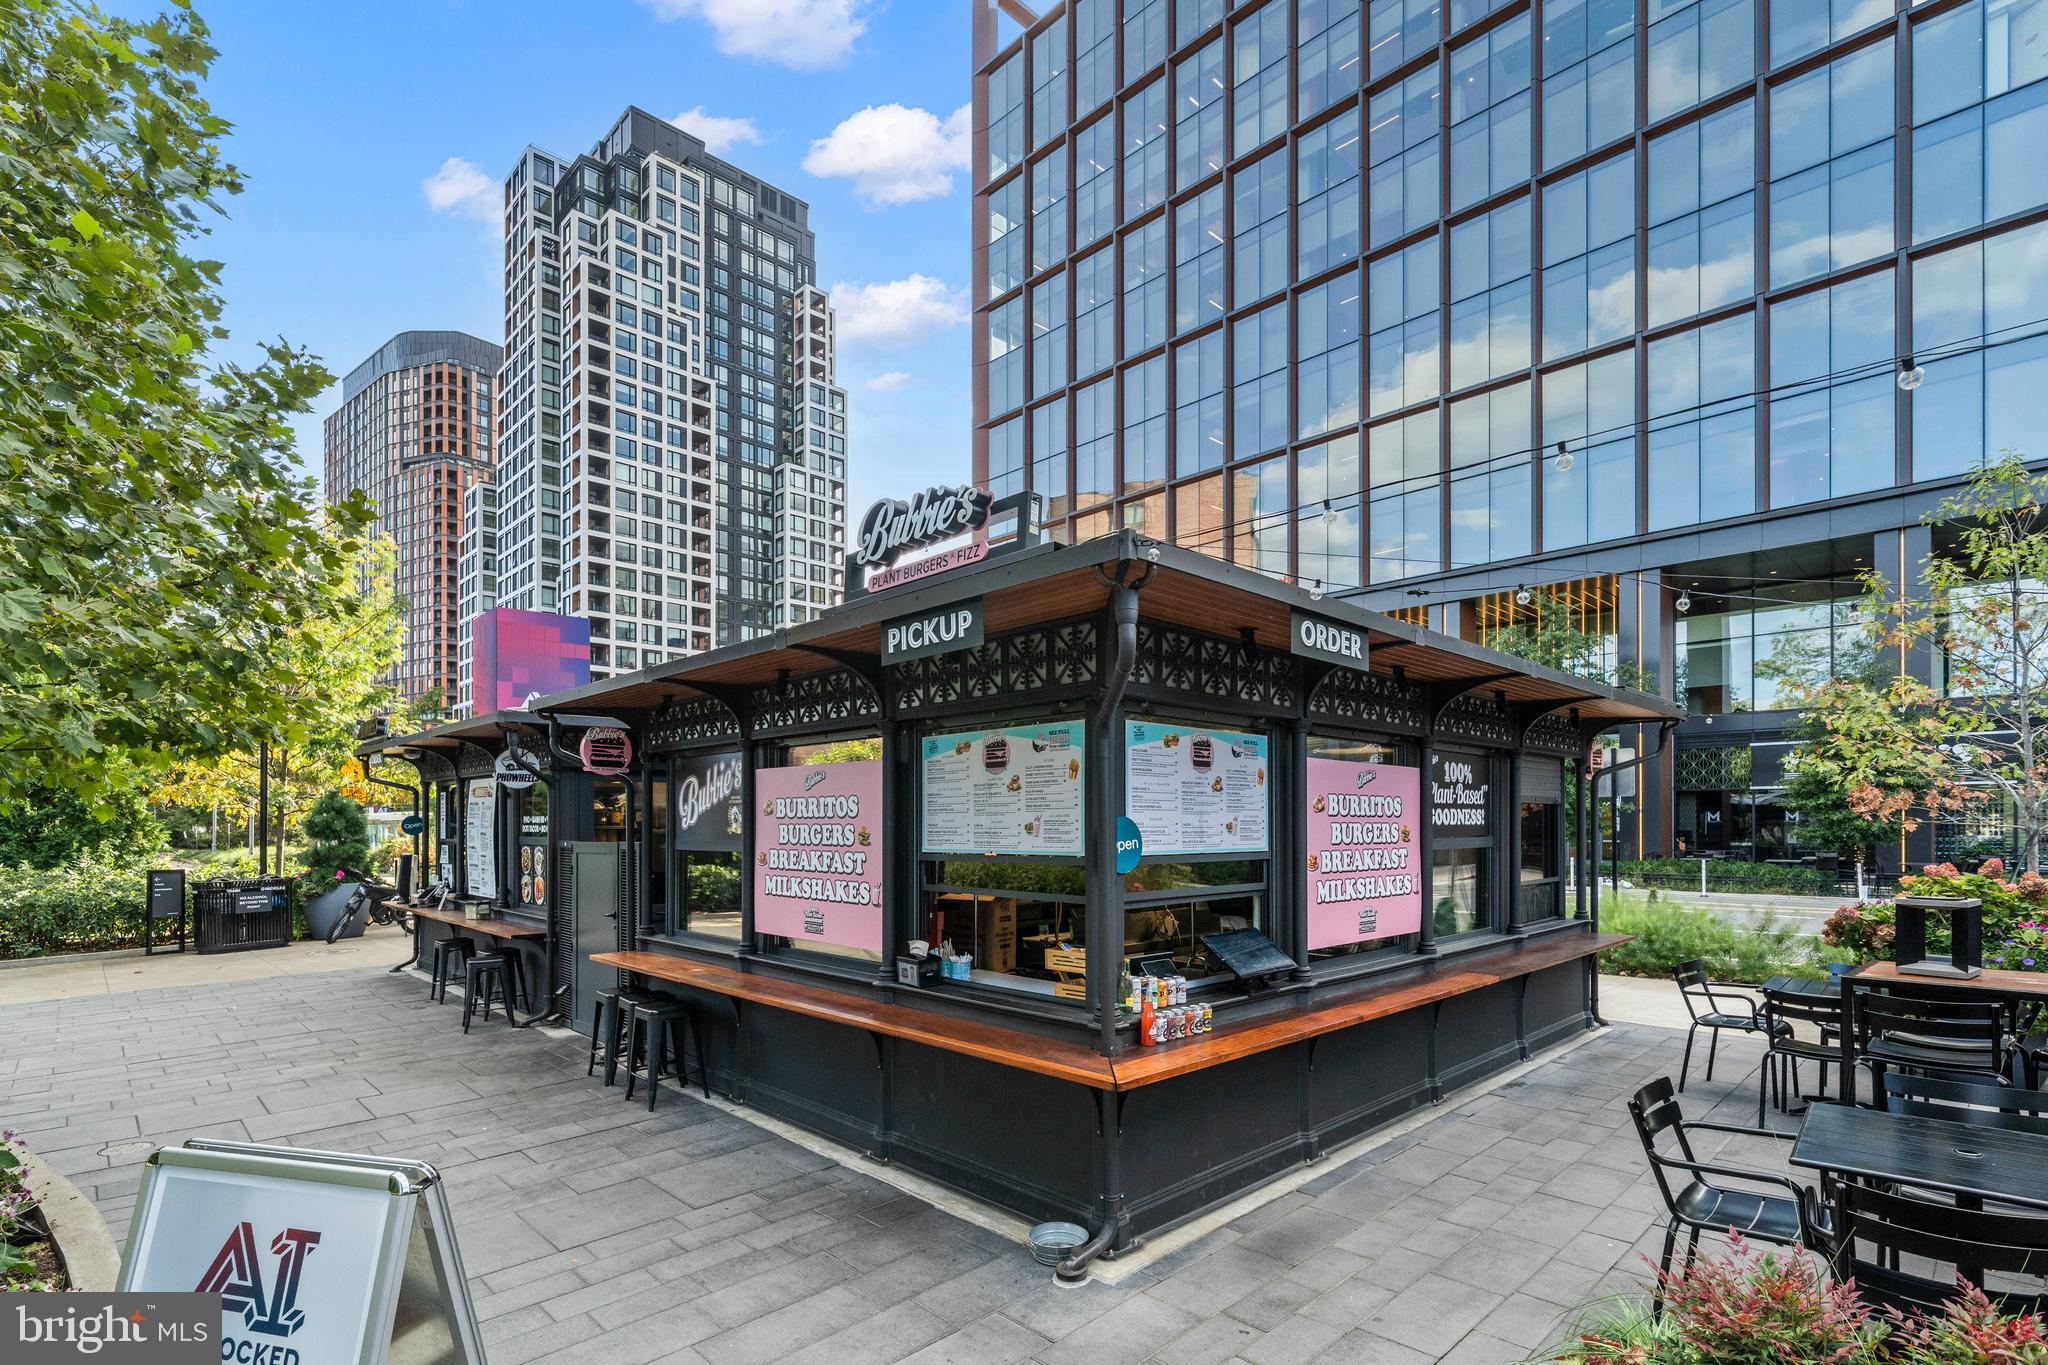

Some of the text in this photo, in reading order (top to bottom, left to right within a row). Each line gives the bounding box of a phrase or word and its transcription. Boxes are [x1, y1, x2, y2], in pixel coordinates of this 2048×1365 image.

[857, 486, 978, 565] Bubbie's
[872, 569, 901, 590] PLANT
[904, 554, 949, 580] BURGERS
[957, 544, 980, 564] FIZZ
[887, 610, 973, 654] PICKUP
[1300, 620, 1362, 659] ORDER
[586, 727, 626, 740] Bubbie's
[1444, 761, 1473, 785] 100%
[679, 759, 742, 830] Bubbie's
[775, 795, 859, 819] BURRITOS
[1327, 793, 1402, 818] BURRITOS
[778, 824, 855, 847] BURGERS
[1116, 839, 1139, 853] pen
[1330, 822, 1399, 845] BURGERS
[768, 848, 867, 875] BREAKFAST
[1320, 848, 1408, 874] BREAKFAST
[764, 875, 871, 905] MILKSHAKES
[1316, 874, 1412, 904] MILKSHAKES
